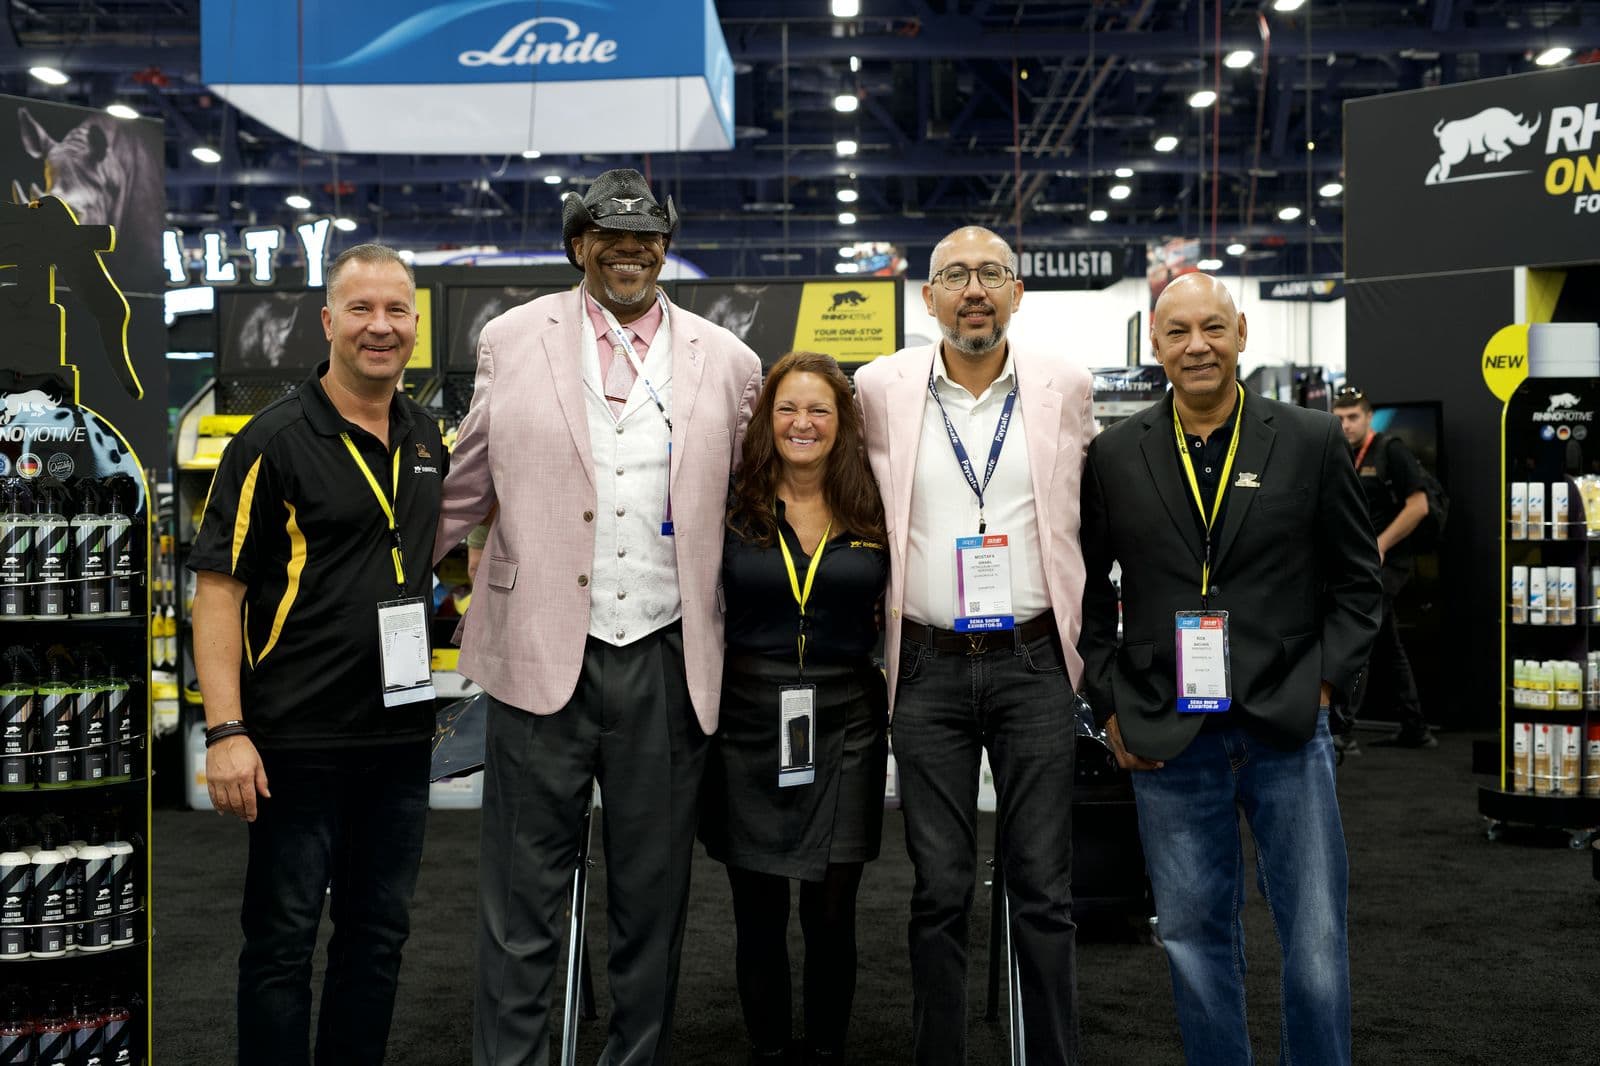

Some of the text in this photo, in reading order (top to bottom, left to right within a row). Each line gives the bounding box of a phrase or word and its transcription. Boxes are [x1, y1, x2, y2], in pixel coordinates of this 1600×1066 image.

[458, 17, 617, 67] Linde
[1545, 155, 1600, 195] ON
[814, 328, 837, 336] YOUR
[1485, 355, 1524, 369] NEW
[995, 412, 1011, 443] Paysafe
[1532, 411, 1594, 422] RHINOMOTIVE
[961, 459, 978, 490] Paysafe
